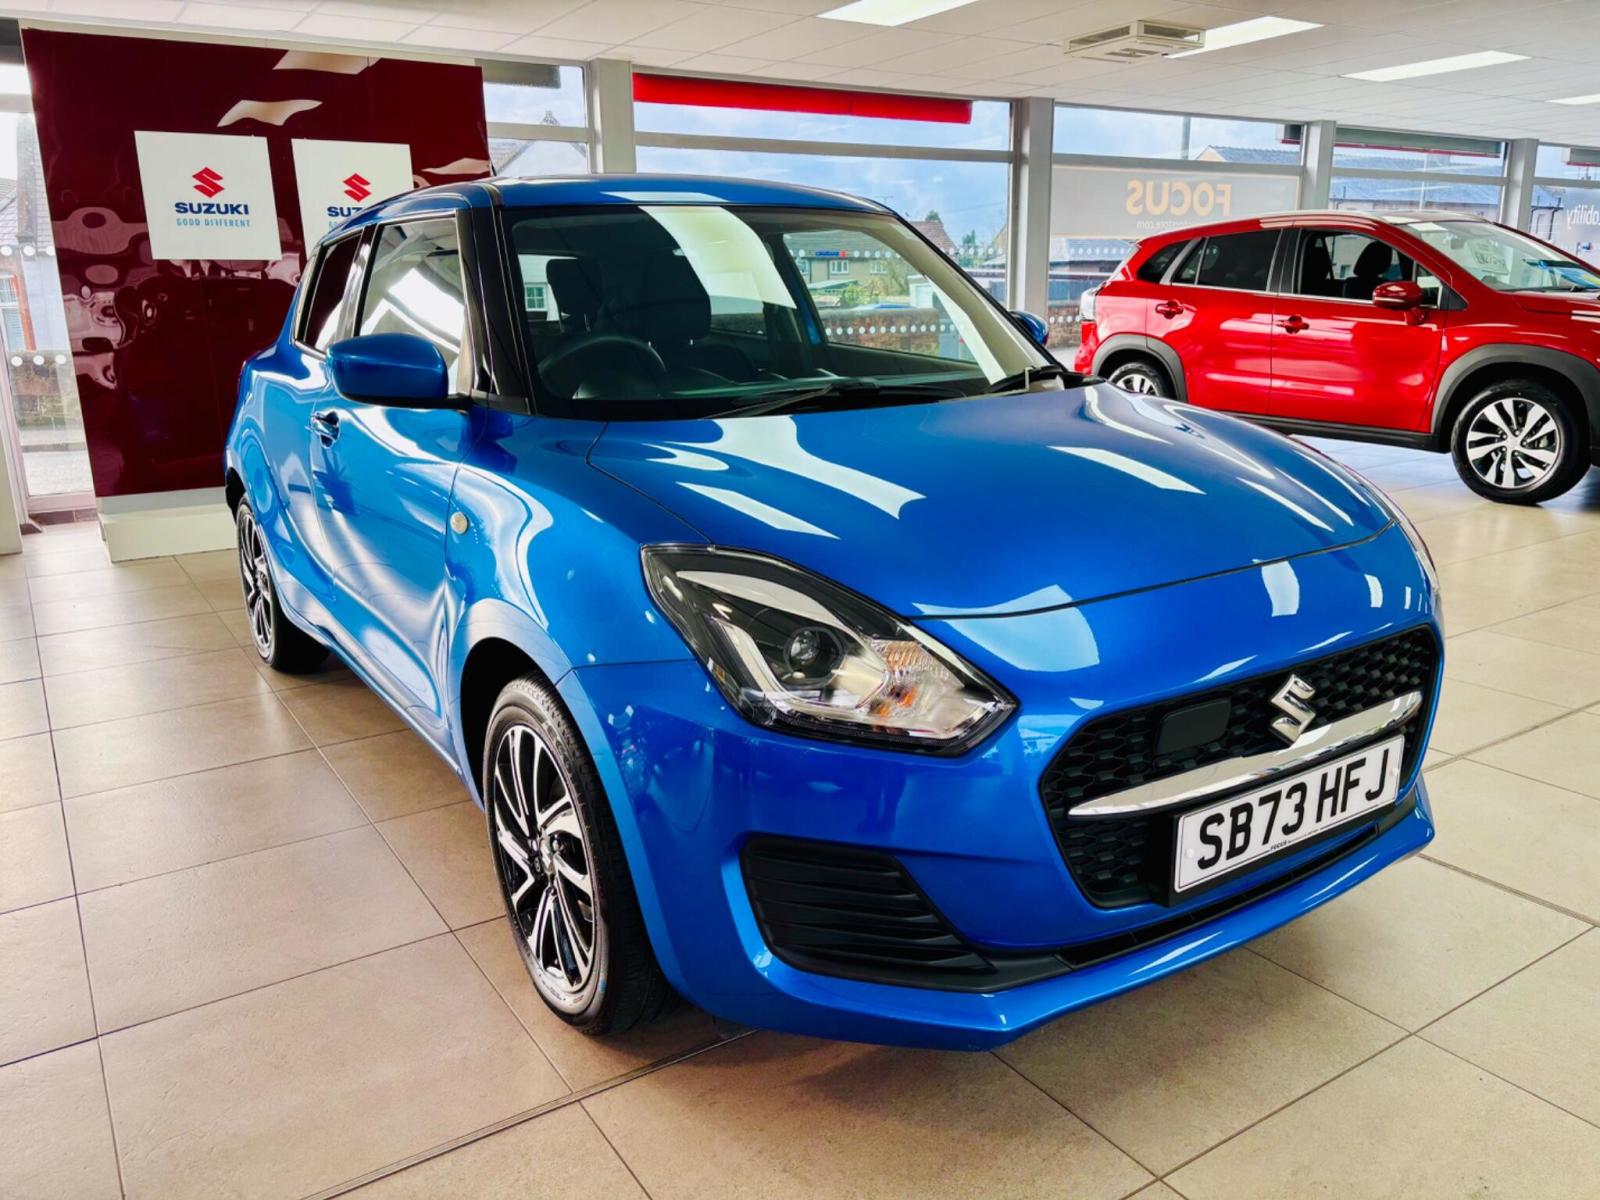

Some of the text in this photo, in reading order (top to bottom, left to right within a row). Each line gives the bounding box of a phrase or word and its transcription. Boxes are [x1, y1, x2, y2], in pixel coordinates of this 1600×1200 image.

[174, 202, 249, 215] SUZUKI
[327, 206, 363, 217] SUZ
[176, 218, 250, 228] GOOD DIFFERENT
[1197, 748, 1390, 870] SB73 HFJ
